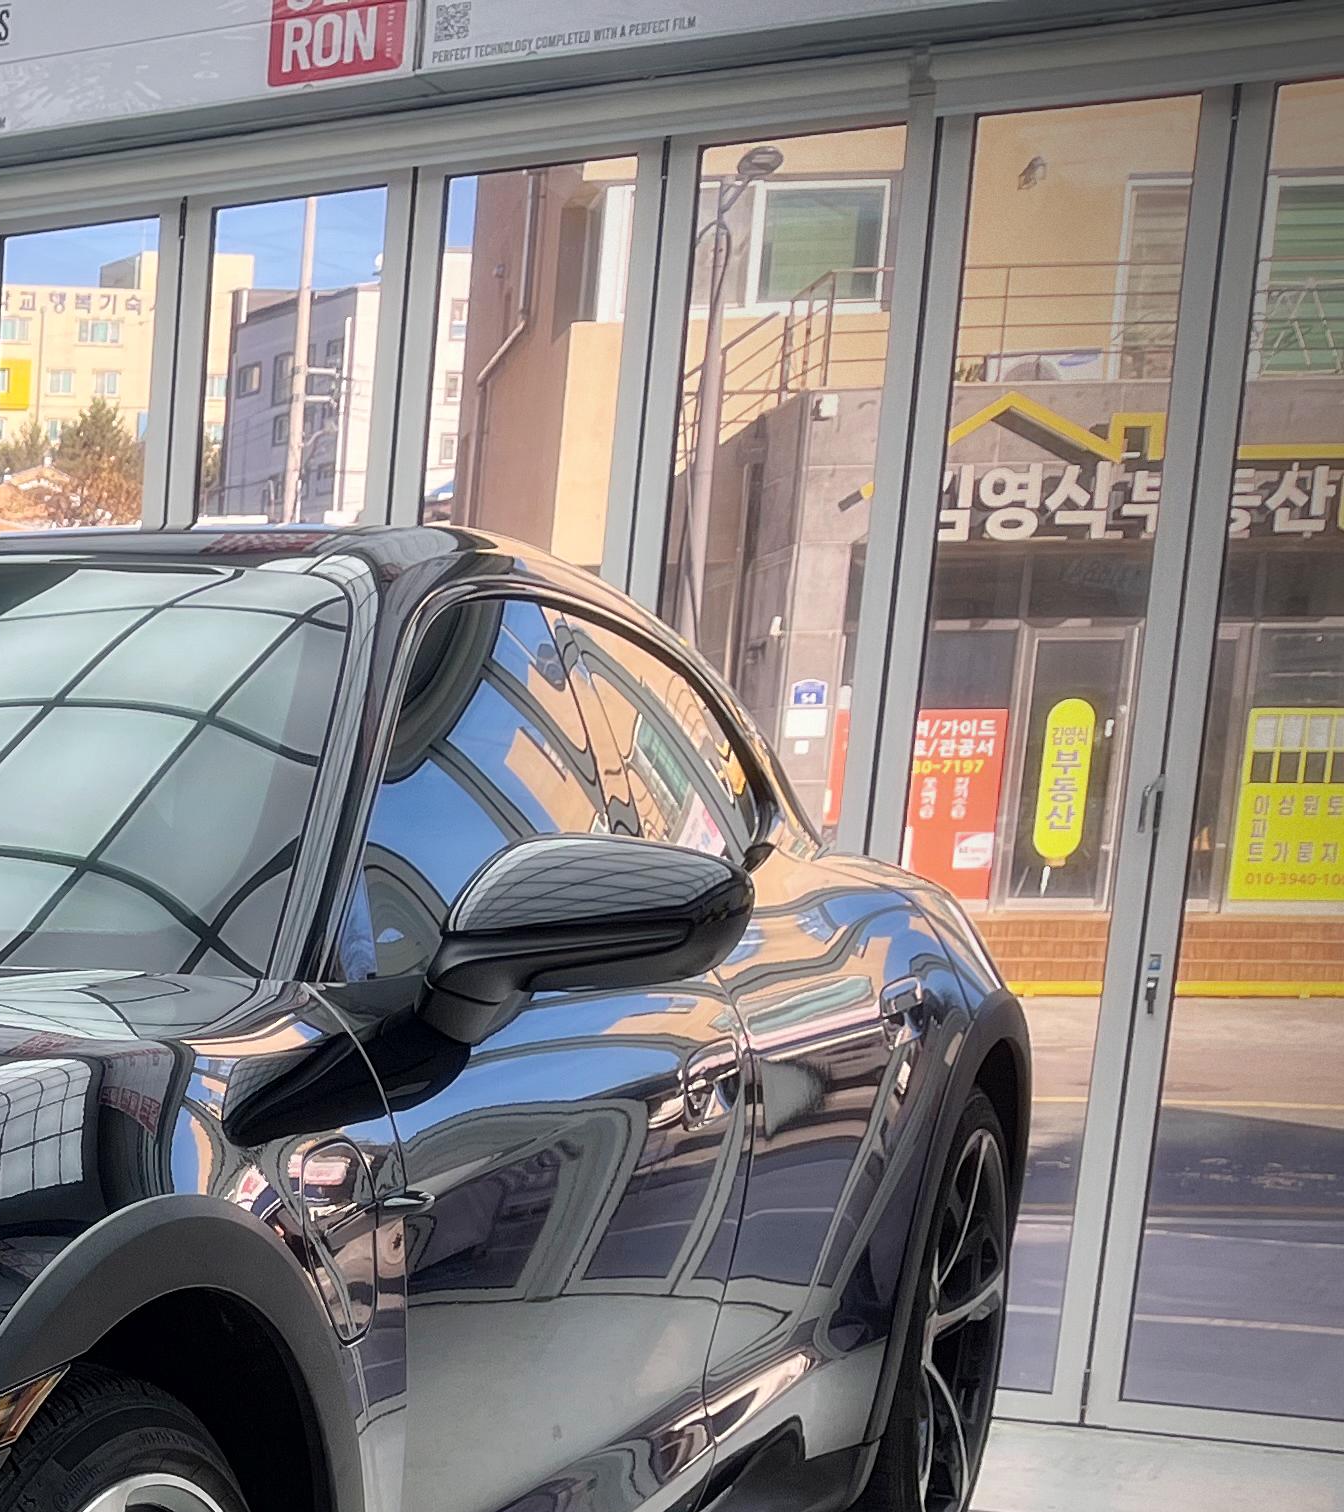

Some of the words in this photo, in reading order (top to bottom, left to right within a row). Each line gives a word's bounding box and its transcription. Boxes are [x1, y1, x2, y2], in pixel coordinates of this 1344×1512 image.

[281, 6, 378, 73] RON
[594, 27, 618, 41] WITH
[672, 16, 697, 31] FILM
[1046, 750, 1082, 830] 부동산
